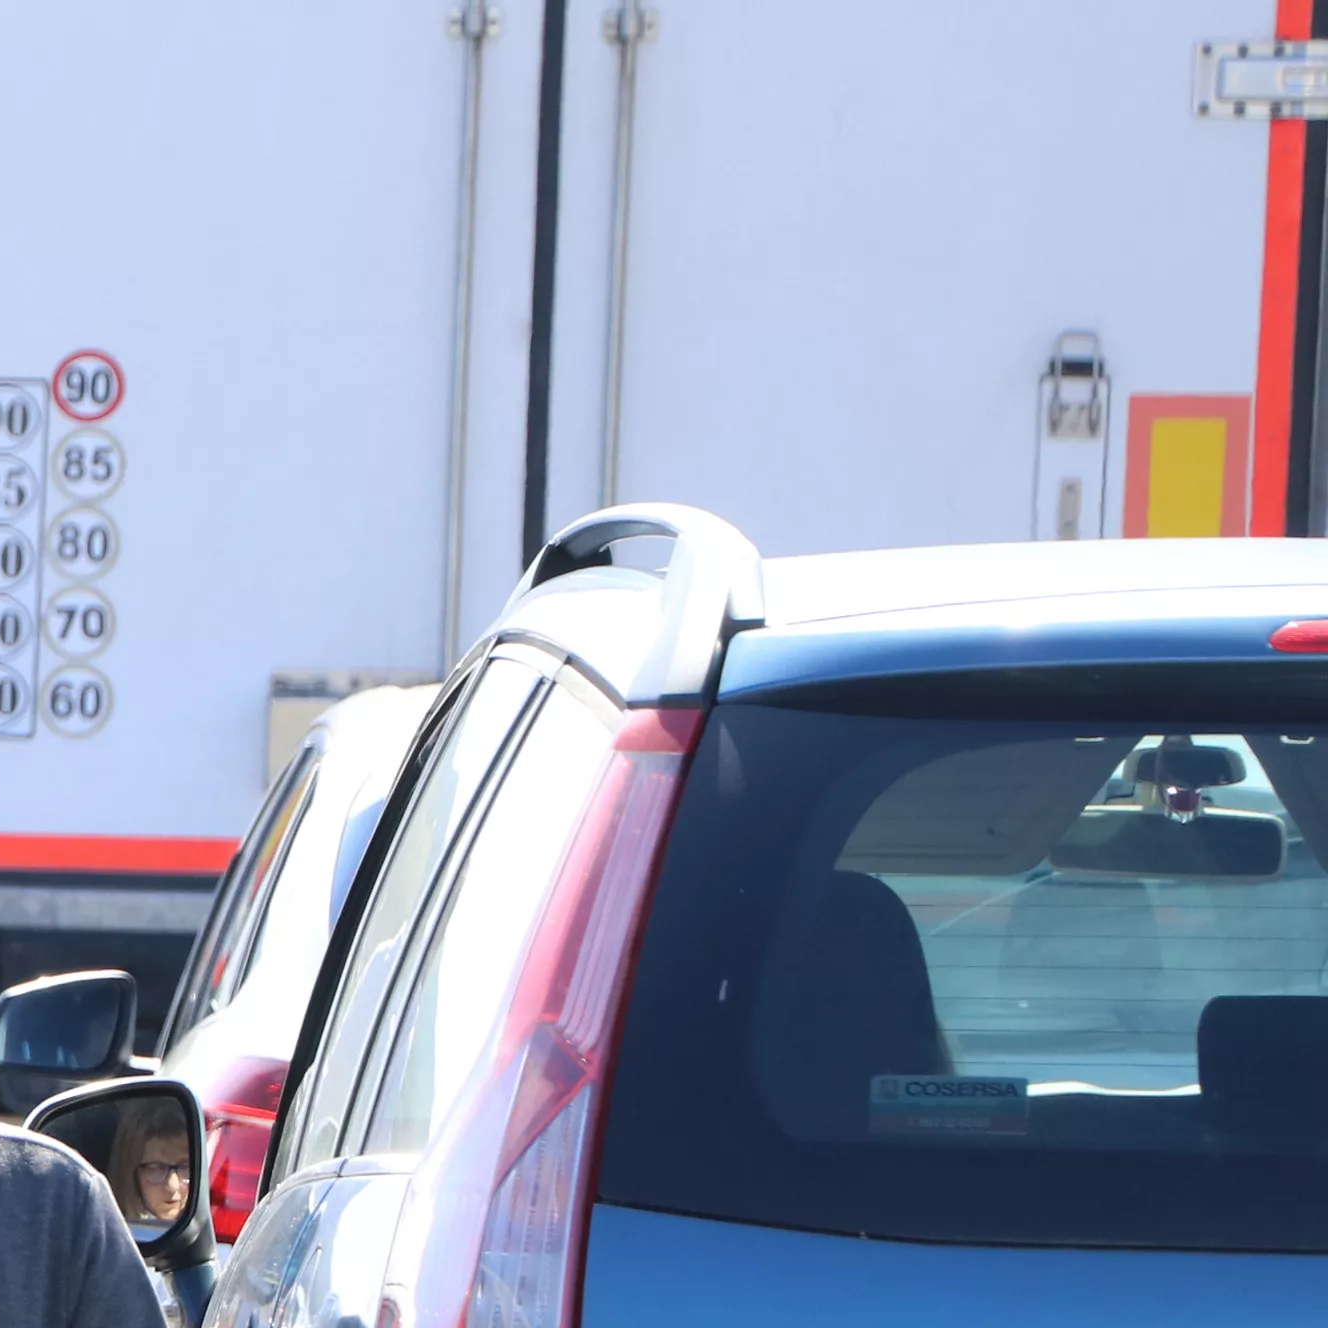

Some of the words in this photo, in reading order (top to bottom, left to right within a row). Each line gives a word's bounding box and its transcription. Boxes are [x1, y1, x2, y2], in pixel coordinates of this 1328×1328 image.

[65, 365, 113, 404] 90
[62, 445, 114, 482] 85
[57, 522, 109, 562] 80
[56, 604, 105, 639] 70
[49, 682, 102, 720] 60
[905, 1081, 1019, 1097] COSERSA
